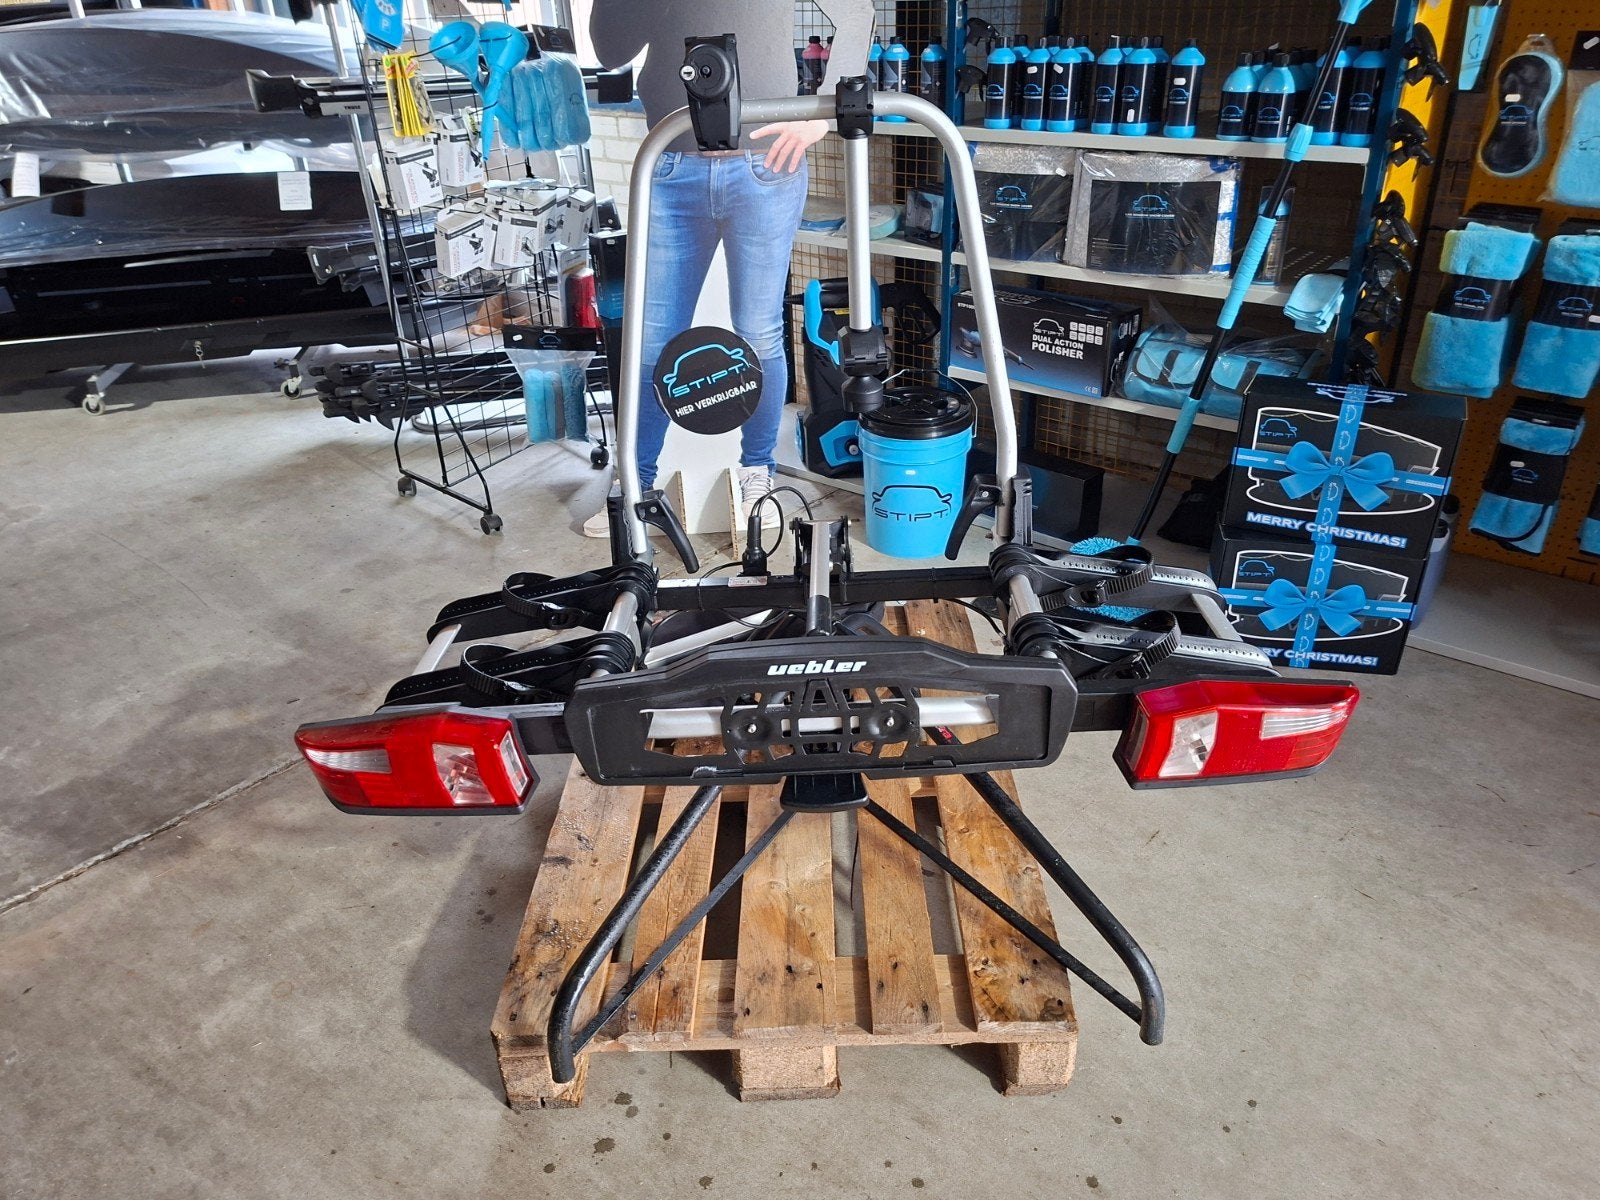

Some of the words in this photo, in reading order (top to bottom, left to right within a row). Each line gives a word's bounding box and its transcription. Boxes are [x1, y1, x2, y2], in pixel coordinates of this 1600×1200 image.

[1034, 328, 1063, 337] STIPT
[1031, 341, 1084, 360] POLISHER
[1032, 334, 1053, 344] DUAL
[1054, 338, 1084, 350] ACTION
[672, 363, 744, 397] STIPT
[675, 405, 695, 418] HIER
[695, 380, 757, 410] VERKRIJGBAAR
[1259, 430, 1293, 438] STIPT
[874, 507, 949, 522] STIPT
[1246, 511, 1305, 530] MERRY
[1305, 521, 1408, 549] CHRISTMAS!
[1284, 649, 1378, 667] CHRISTMAS!
[767, 659, 867, 676] uebler
